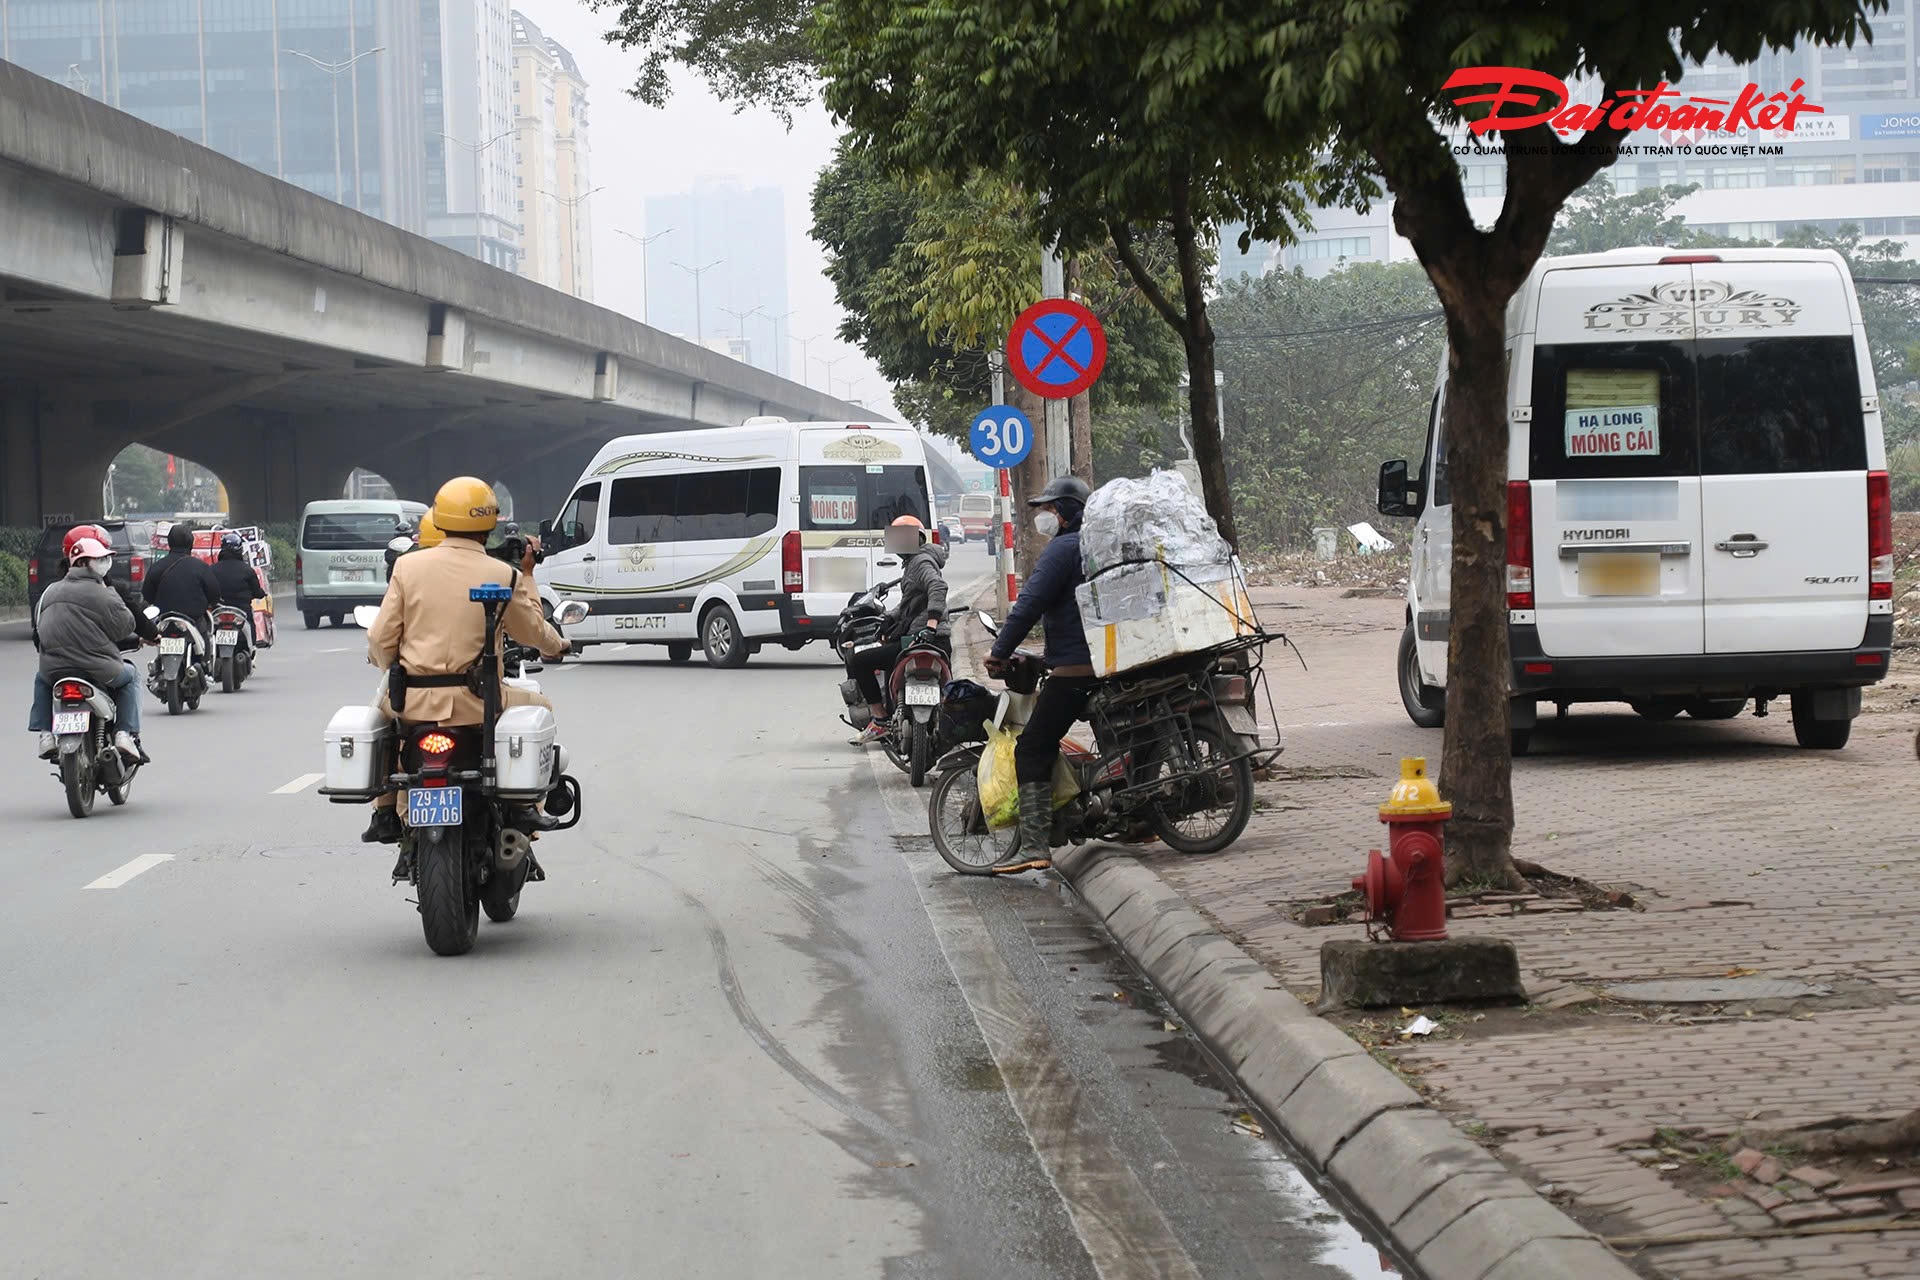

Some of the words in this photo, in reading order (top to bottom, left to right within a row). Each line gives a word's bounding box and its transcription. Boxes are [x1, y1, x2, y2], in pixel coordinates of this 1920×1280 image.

[1669, 288, 1717, 302] VIP
[1583, 308, 1803, 330] LUXURY
[1603, 412, 1643, 426] LONG
[978, 417, 1024, 456] 30
[1571, 427, 1621, 454] MÓNG
[1625, 427, 1653, 451] CÁI
[811, 495, 838, 520] MÓNG
[1563, 528, 1630, 540] HYUNDAI
[846, 538, 885, 547] SOLA
[1803, 575, 1859, 585] SOLATI
[614, 616, 667, 630] SOLATI
[416, 789, 453, 807] 29-A1
[412, 806, 459, 824] 007.06
